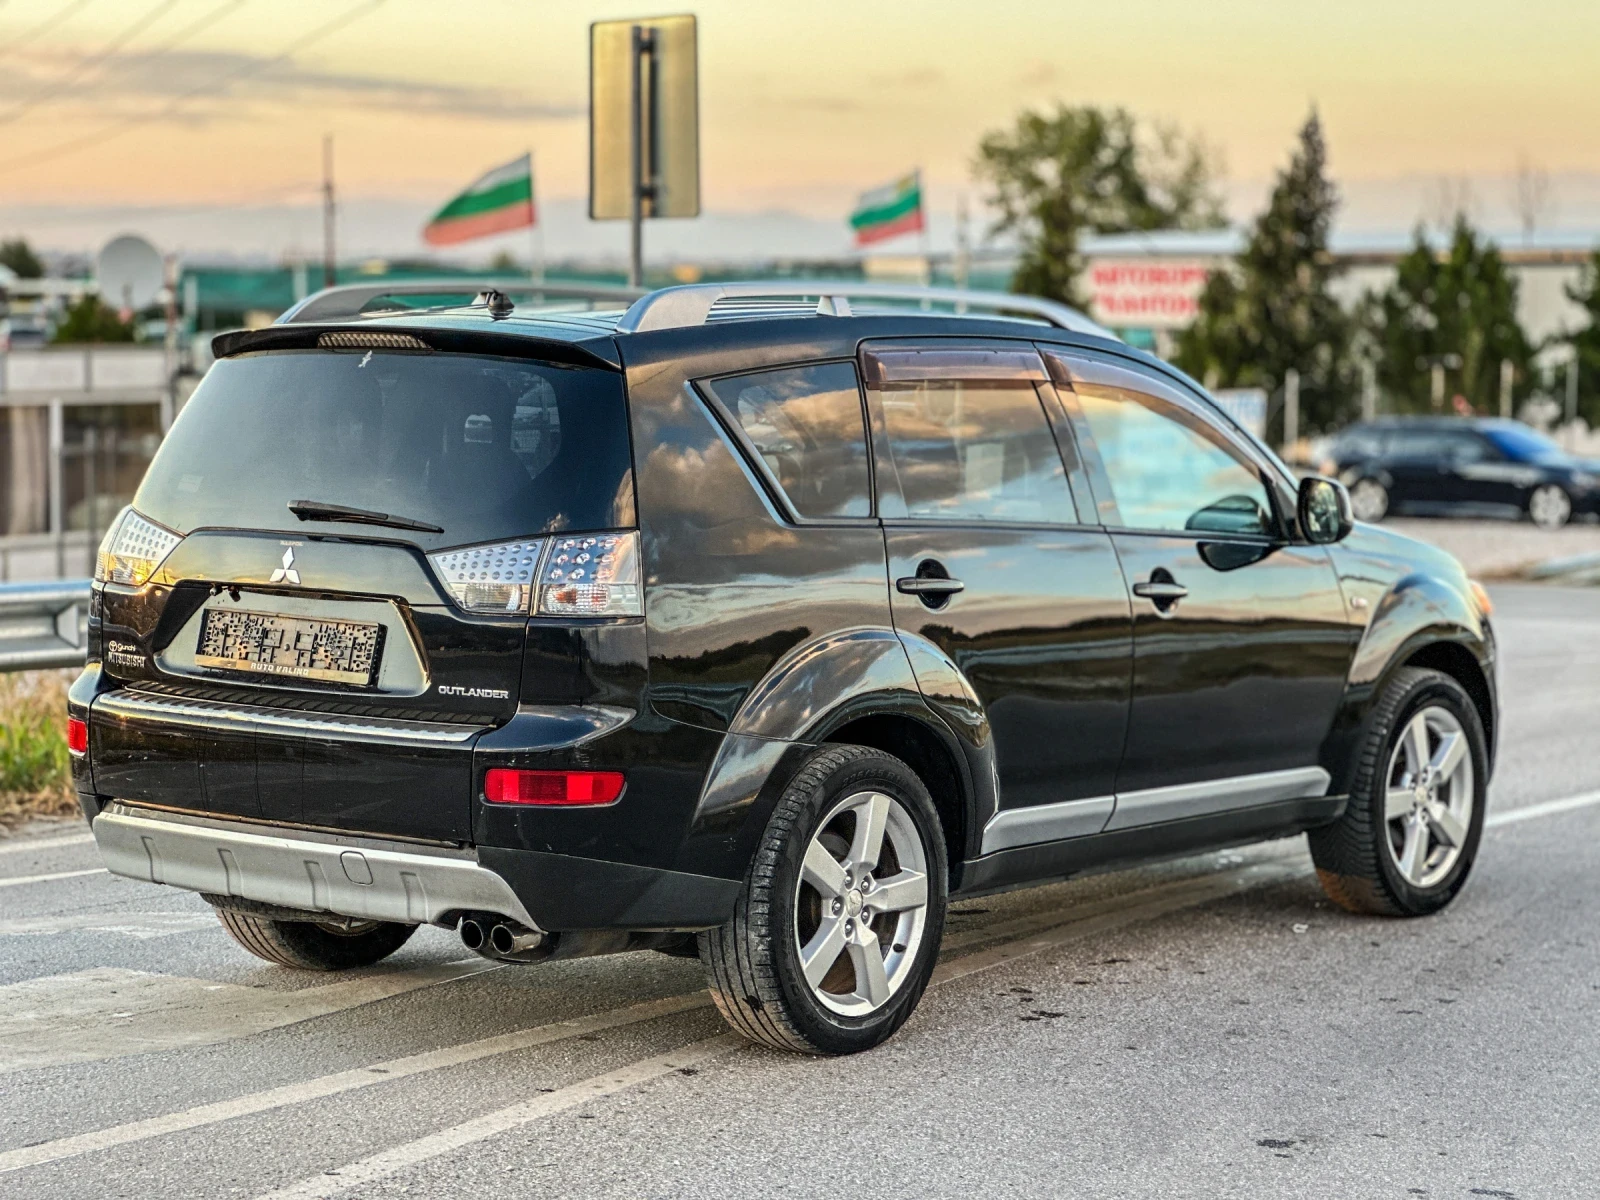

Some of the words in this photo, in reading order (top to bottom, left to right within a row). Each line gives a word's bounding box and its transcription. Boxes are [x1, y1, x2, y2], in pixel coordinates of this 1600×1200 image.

[108, 651, 146, 668] MITSUBISHI
[250, 662, 274, 672] AUTO
[438, 685, 509, 699] OUTLANDER
